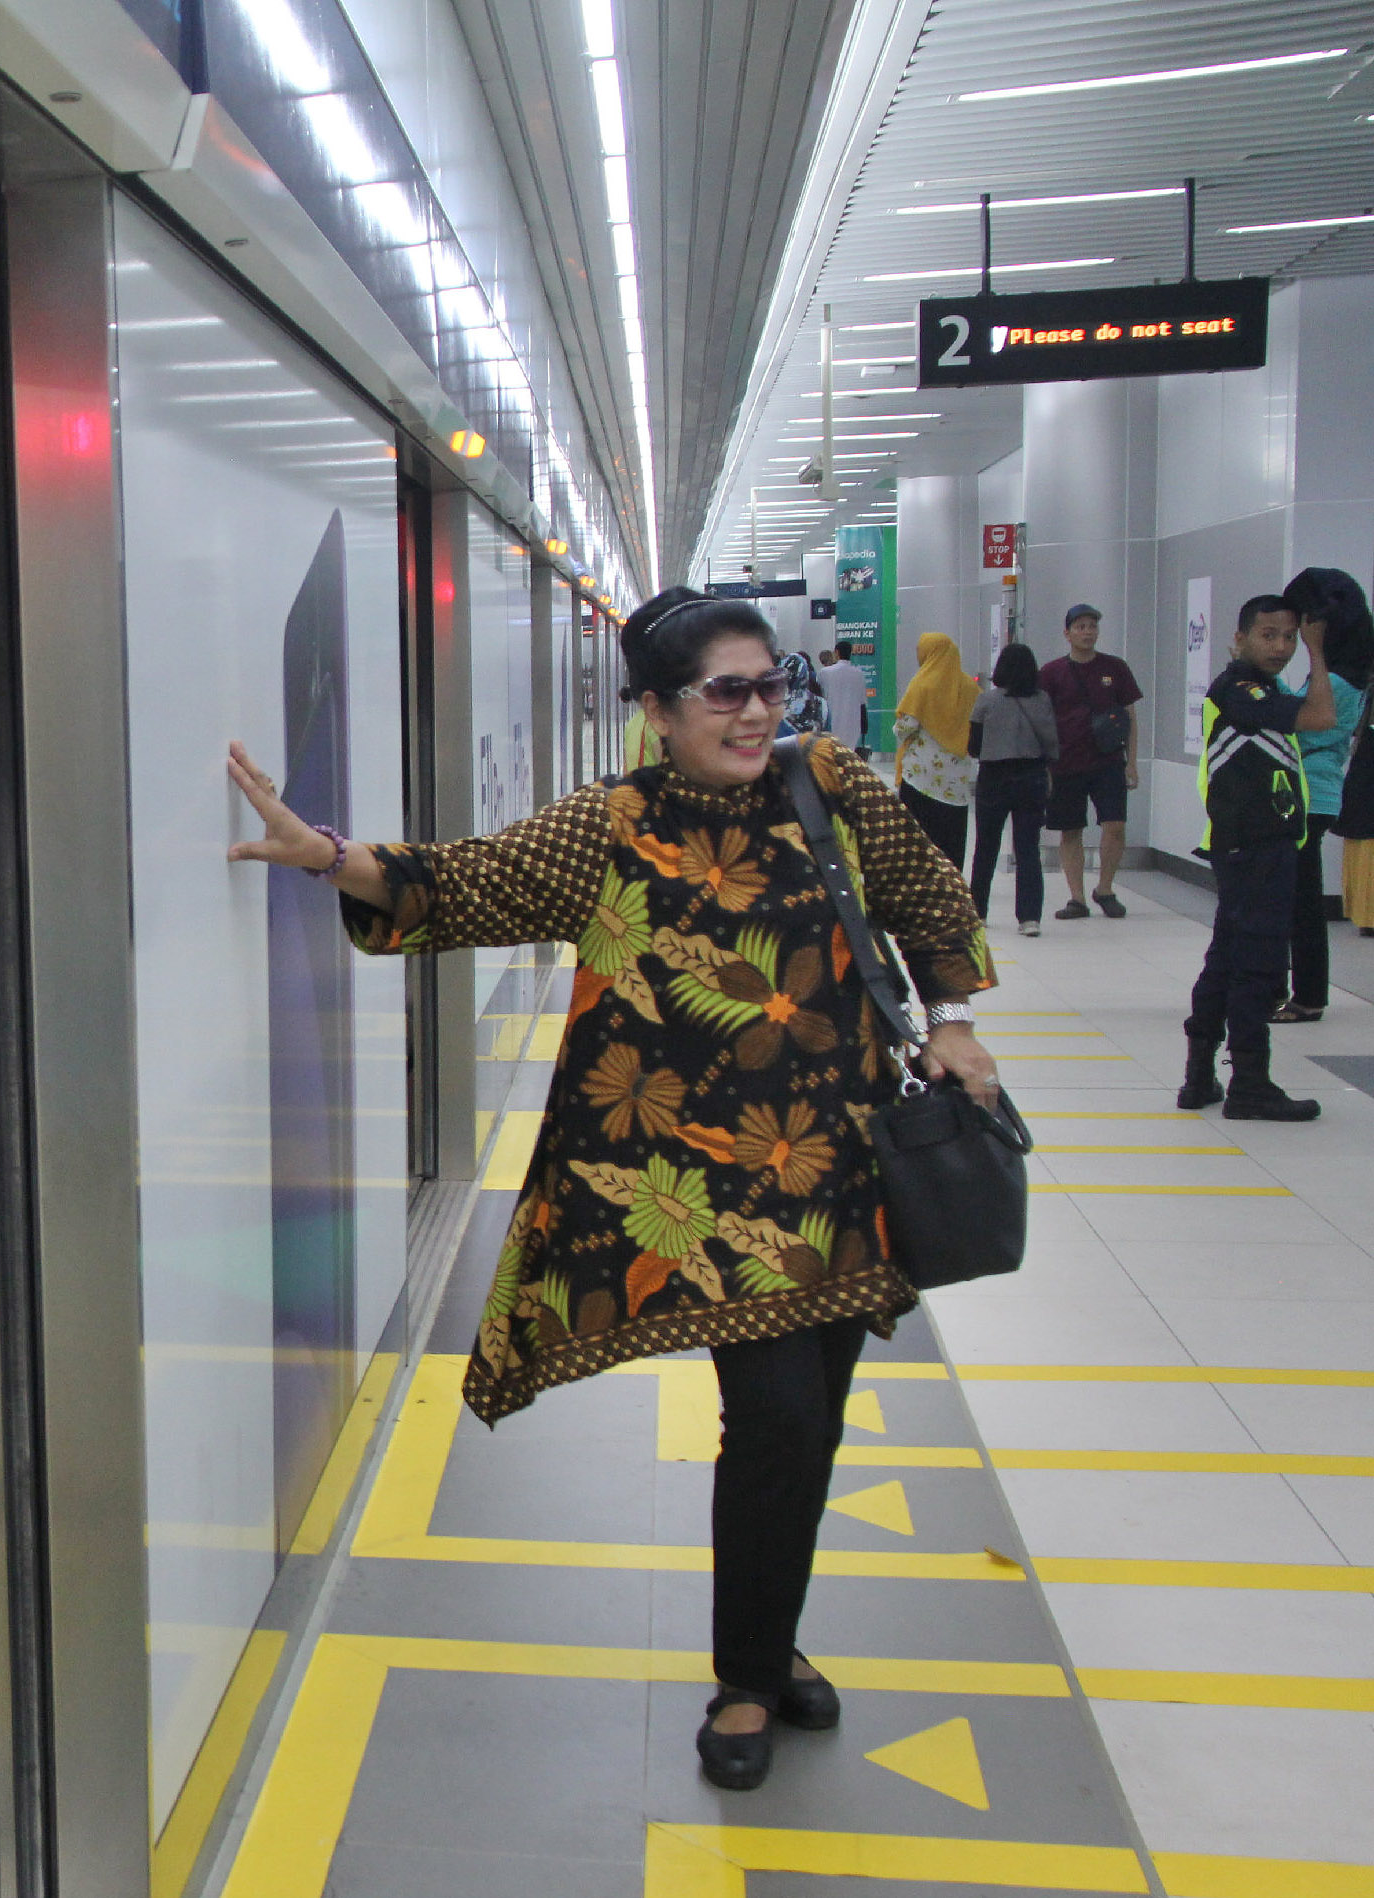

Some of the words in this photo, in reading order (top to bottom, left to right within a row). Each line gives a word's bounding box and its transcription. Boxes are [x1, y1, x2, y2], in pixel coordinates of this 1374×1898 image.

[937, 314, 972, 367] 2
[1009, 327, 1086, 346] Please
[1096, 323, 1123, 341] do
[1130, 321, 1173, 338] not
[1181, 316, 1237, 335] seat
[988, 545, 1010, 554] STOP
